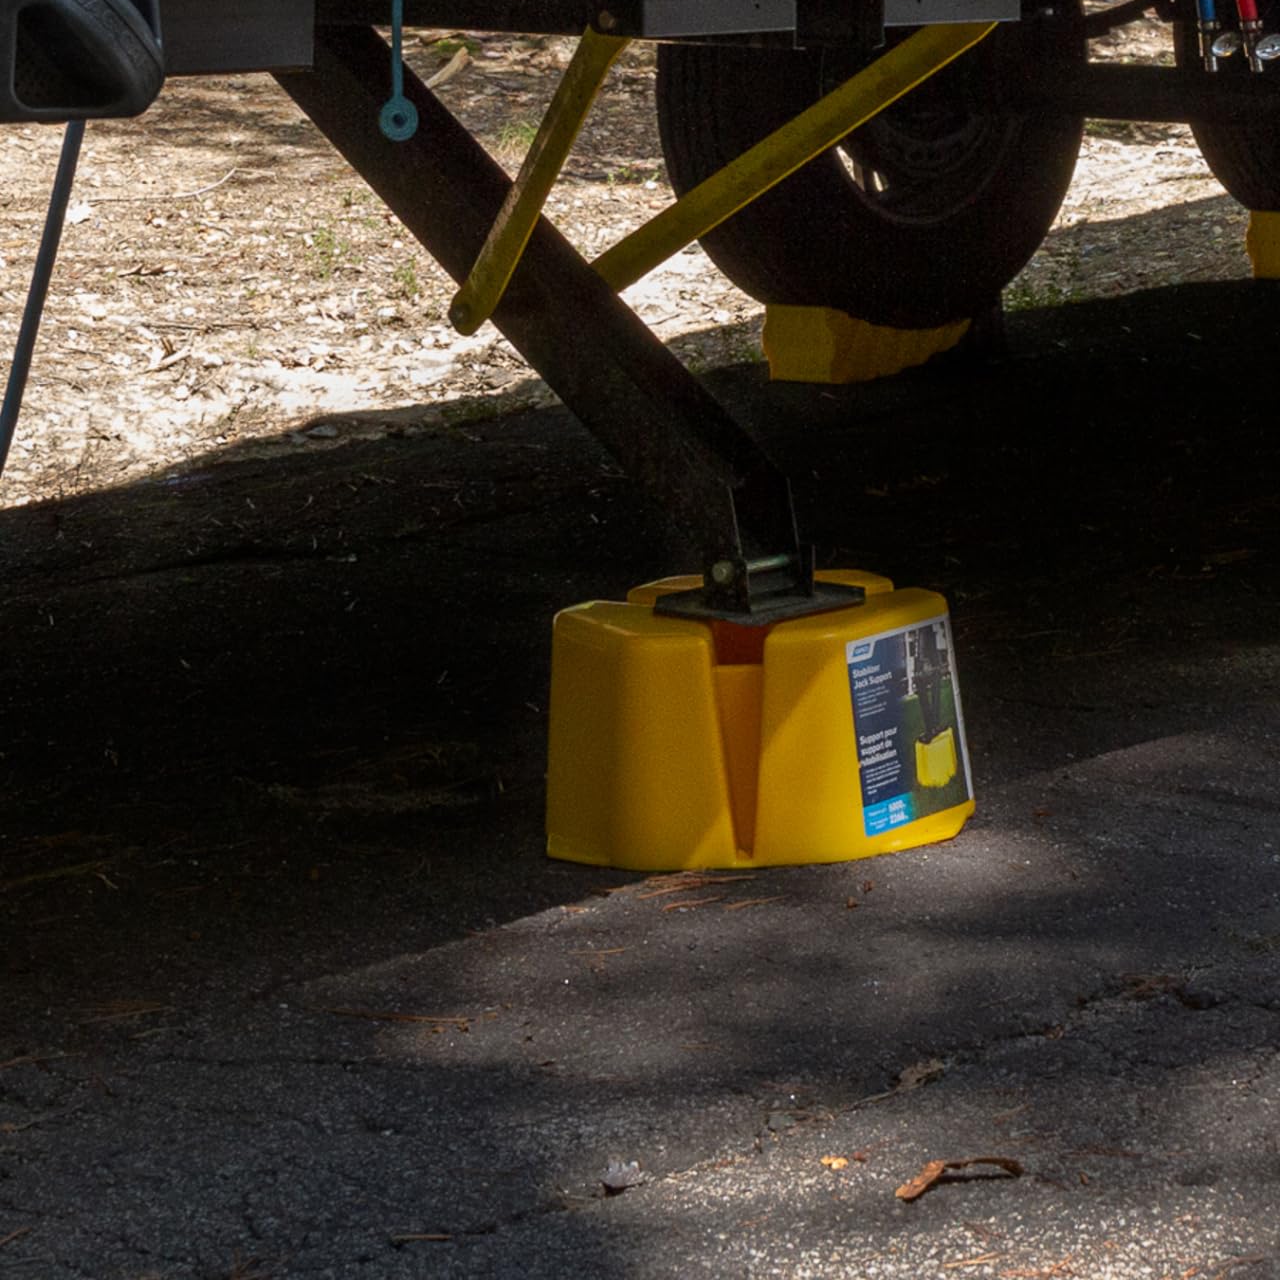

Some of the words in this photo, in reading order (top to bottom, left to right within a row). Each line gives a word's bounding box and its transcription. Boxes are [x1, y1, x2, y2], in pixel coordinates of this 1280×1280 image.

[854, 677, 868, 690] Jack
[869, 671, 893, 685] Support
[860, 731, 884, 745] Support
